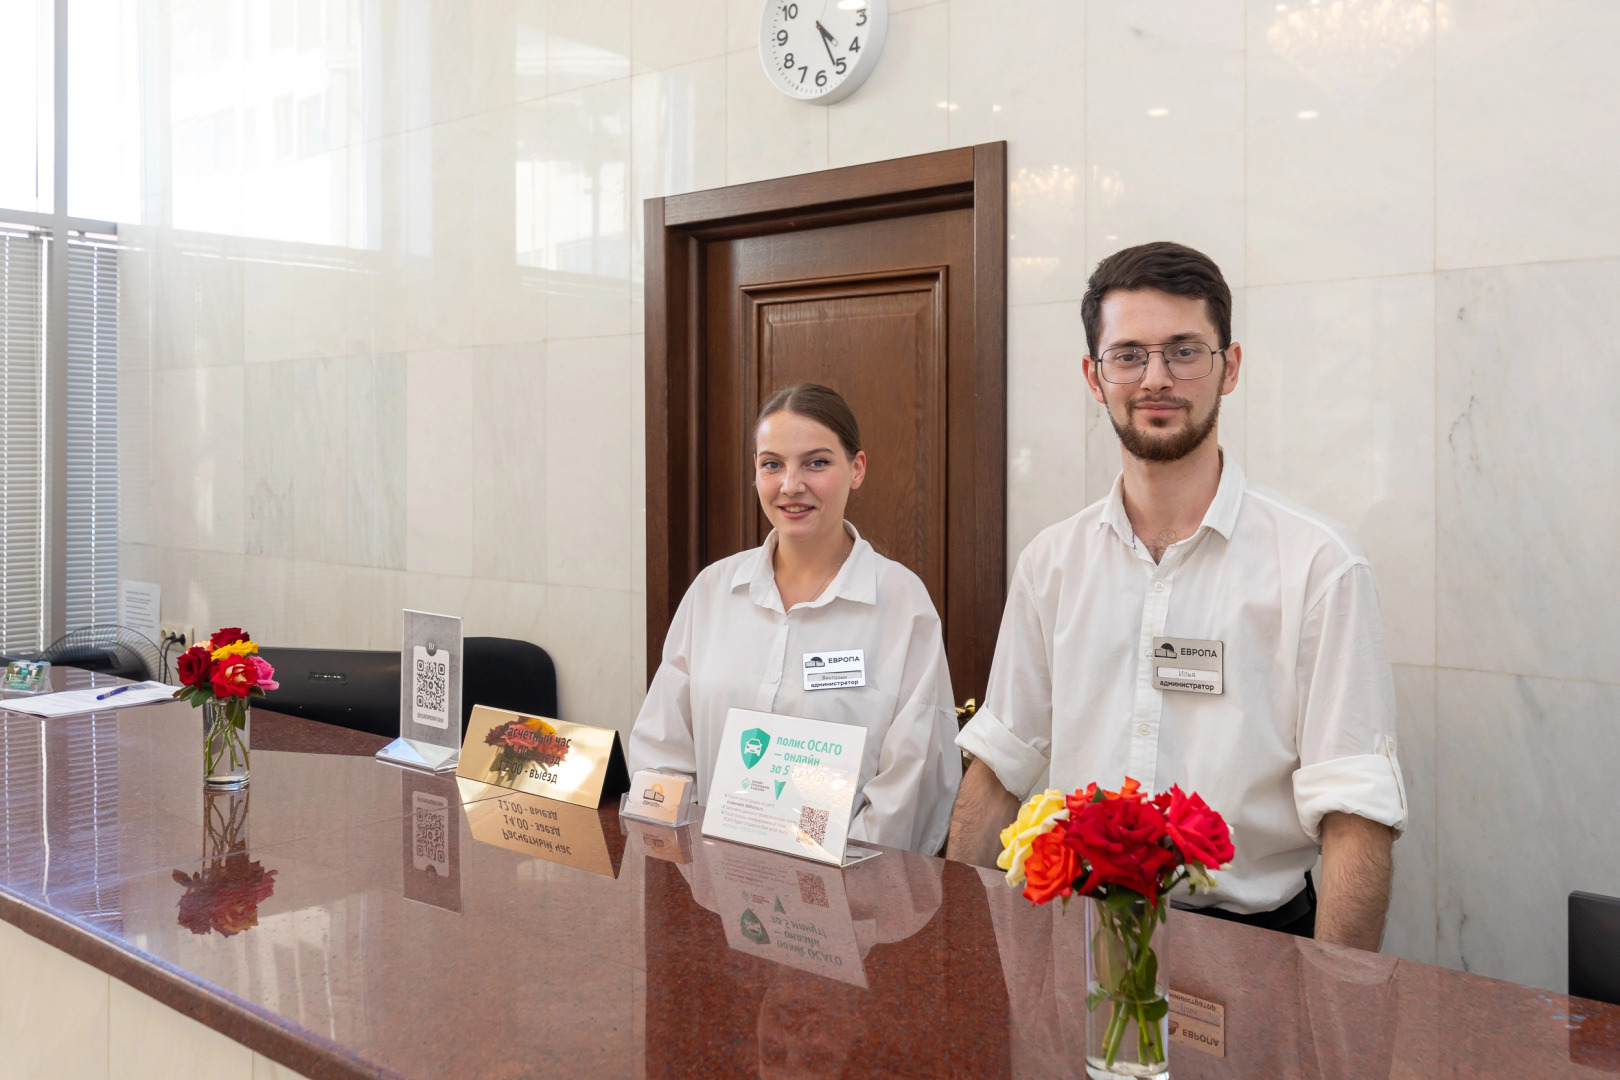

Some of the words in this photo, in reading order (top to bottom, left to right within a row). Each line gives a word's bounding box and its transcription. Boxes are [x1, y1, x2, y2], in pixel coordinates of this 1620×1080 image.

[782, 3, 798, 21] 10
[856, 8, 867, 26] 3
[776, 29, 789, 46] 9
[848, 36, 861, 53] 4
[783, 53, 795, 69] 8
[835, 57, 847, 75] 5
[798, 66, 808, 84] 7
[815, 70, 827, 87] 6
[828, 656, 860, 664] ЕВРОПА
[1180, 647, 1217, 658] ЕВРОПА
[1178, 670, 1196, 678] Илья
[811, 680, 859, 688] администратор
[1160, 680, 1215, 692] администратор
[503, 722, 553, 744] Расчетный
[555, 736, 572, 749] час
[777, 736, 805, 750] полис
[807, 739, 842, 756] ОСАГО
[784, 752, 820, 767] онлайн
[529, 768, 558, 785] выезд
[770, 764, 782, 774] за
[783, 765, 790, 776] 5
